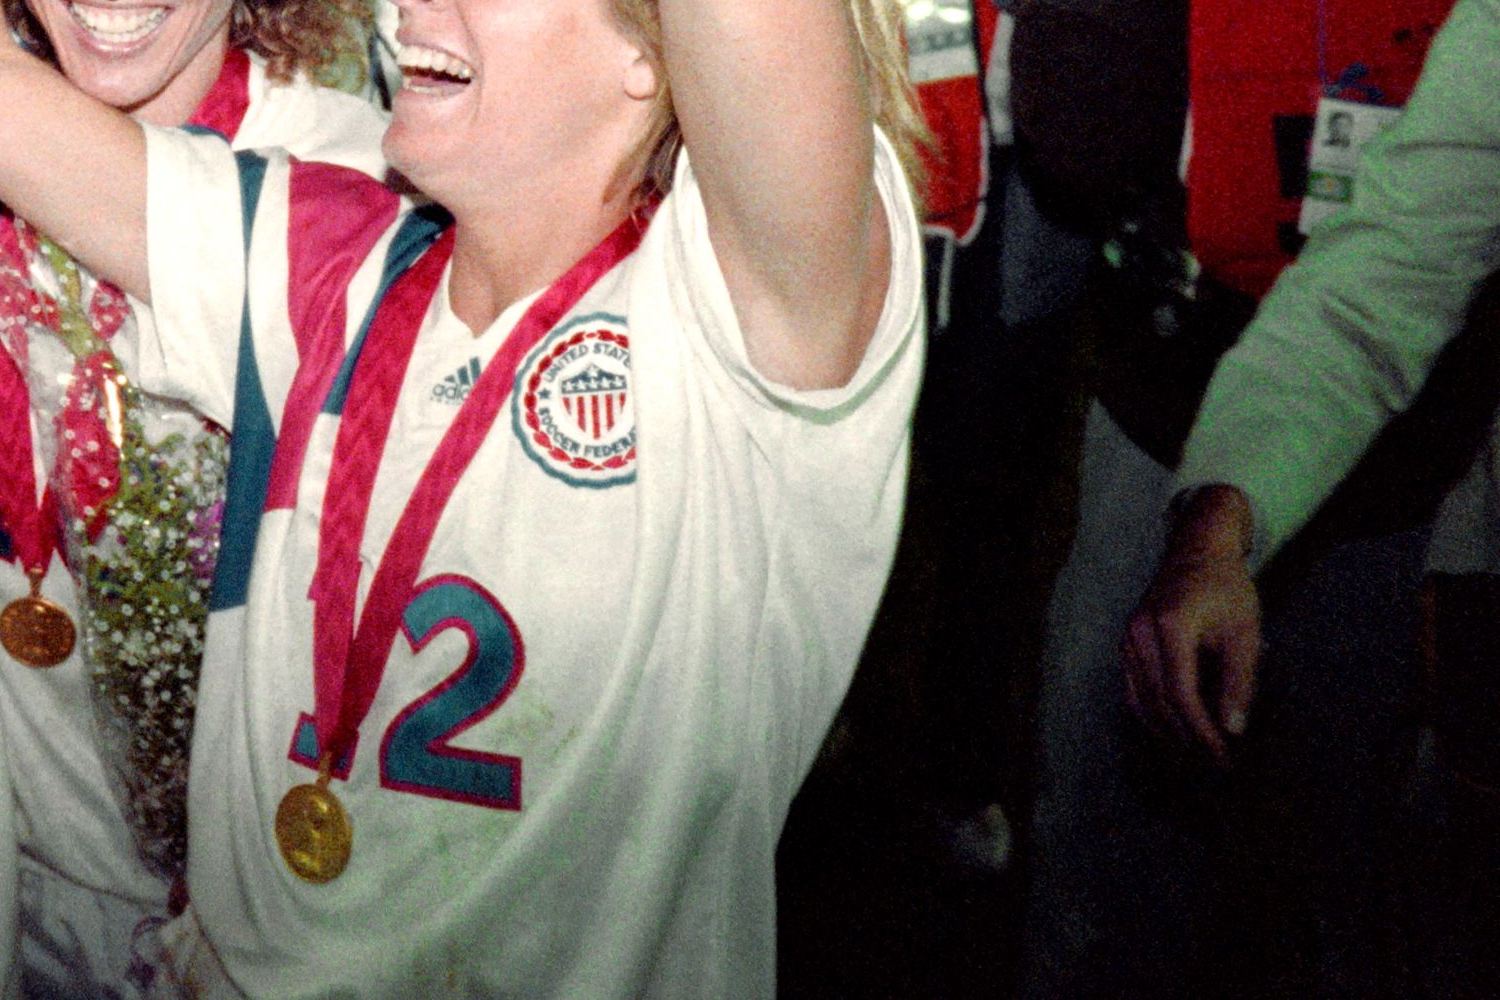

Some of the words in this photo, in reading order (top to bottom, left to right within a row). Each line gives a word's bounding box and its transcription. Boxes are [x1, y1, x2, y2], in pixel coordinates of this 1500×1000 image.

[543, 344, 589, 383] UNITED
[593, 342, 632, 370] STATE
[432, 382, 471, 401] adi
[539, 406, 581, 454] SOCCER
[584, 425, 637, 458] FEDERA
